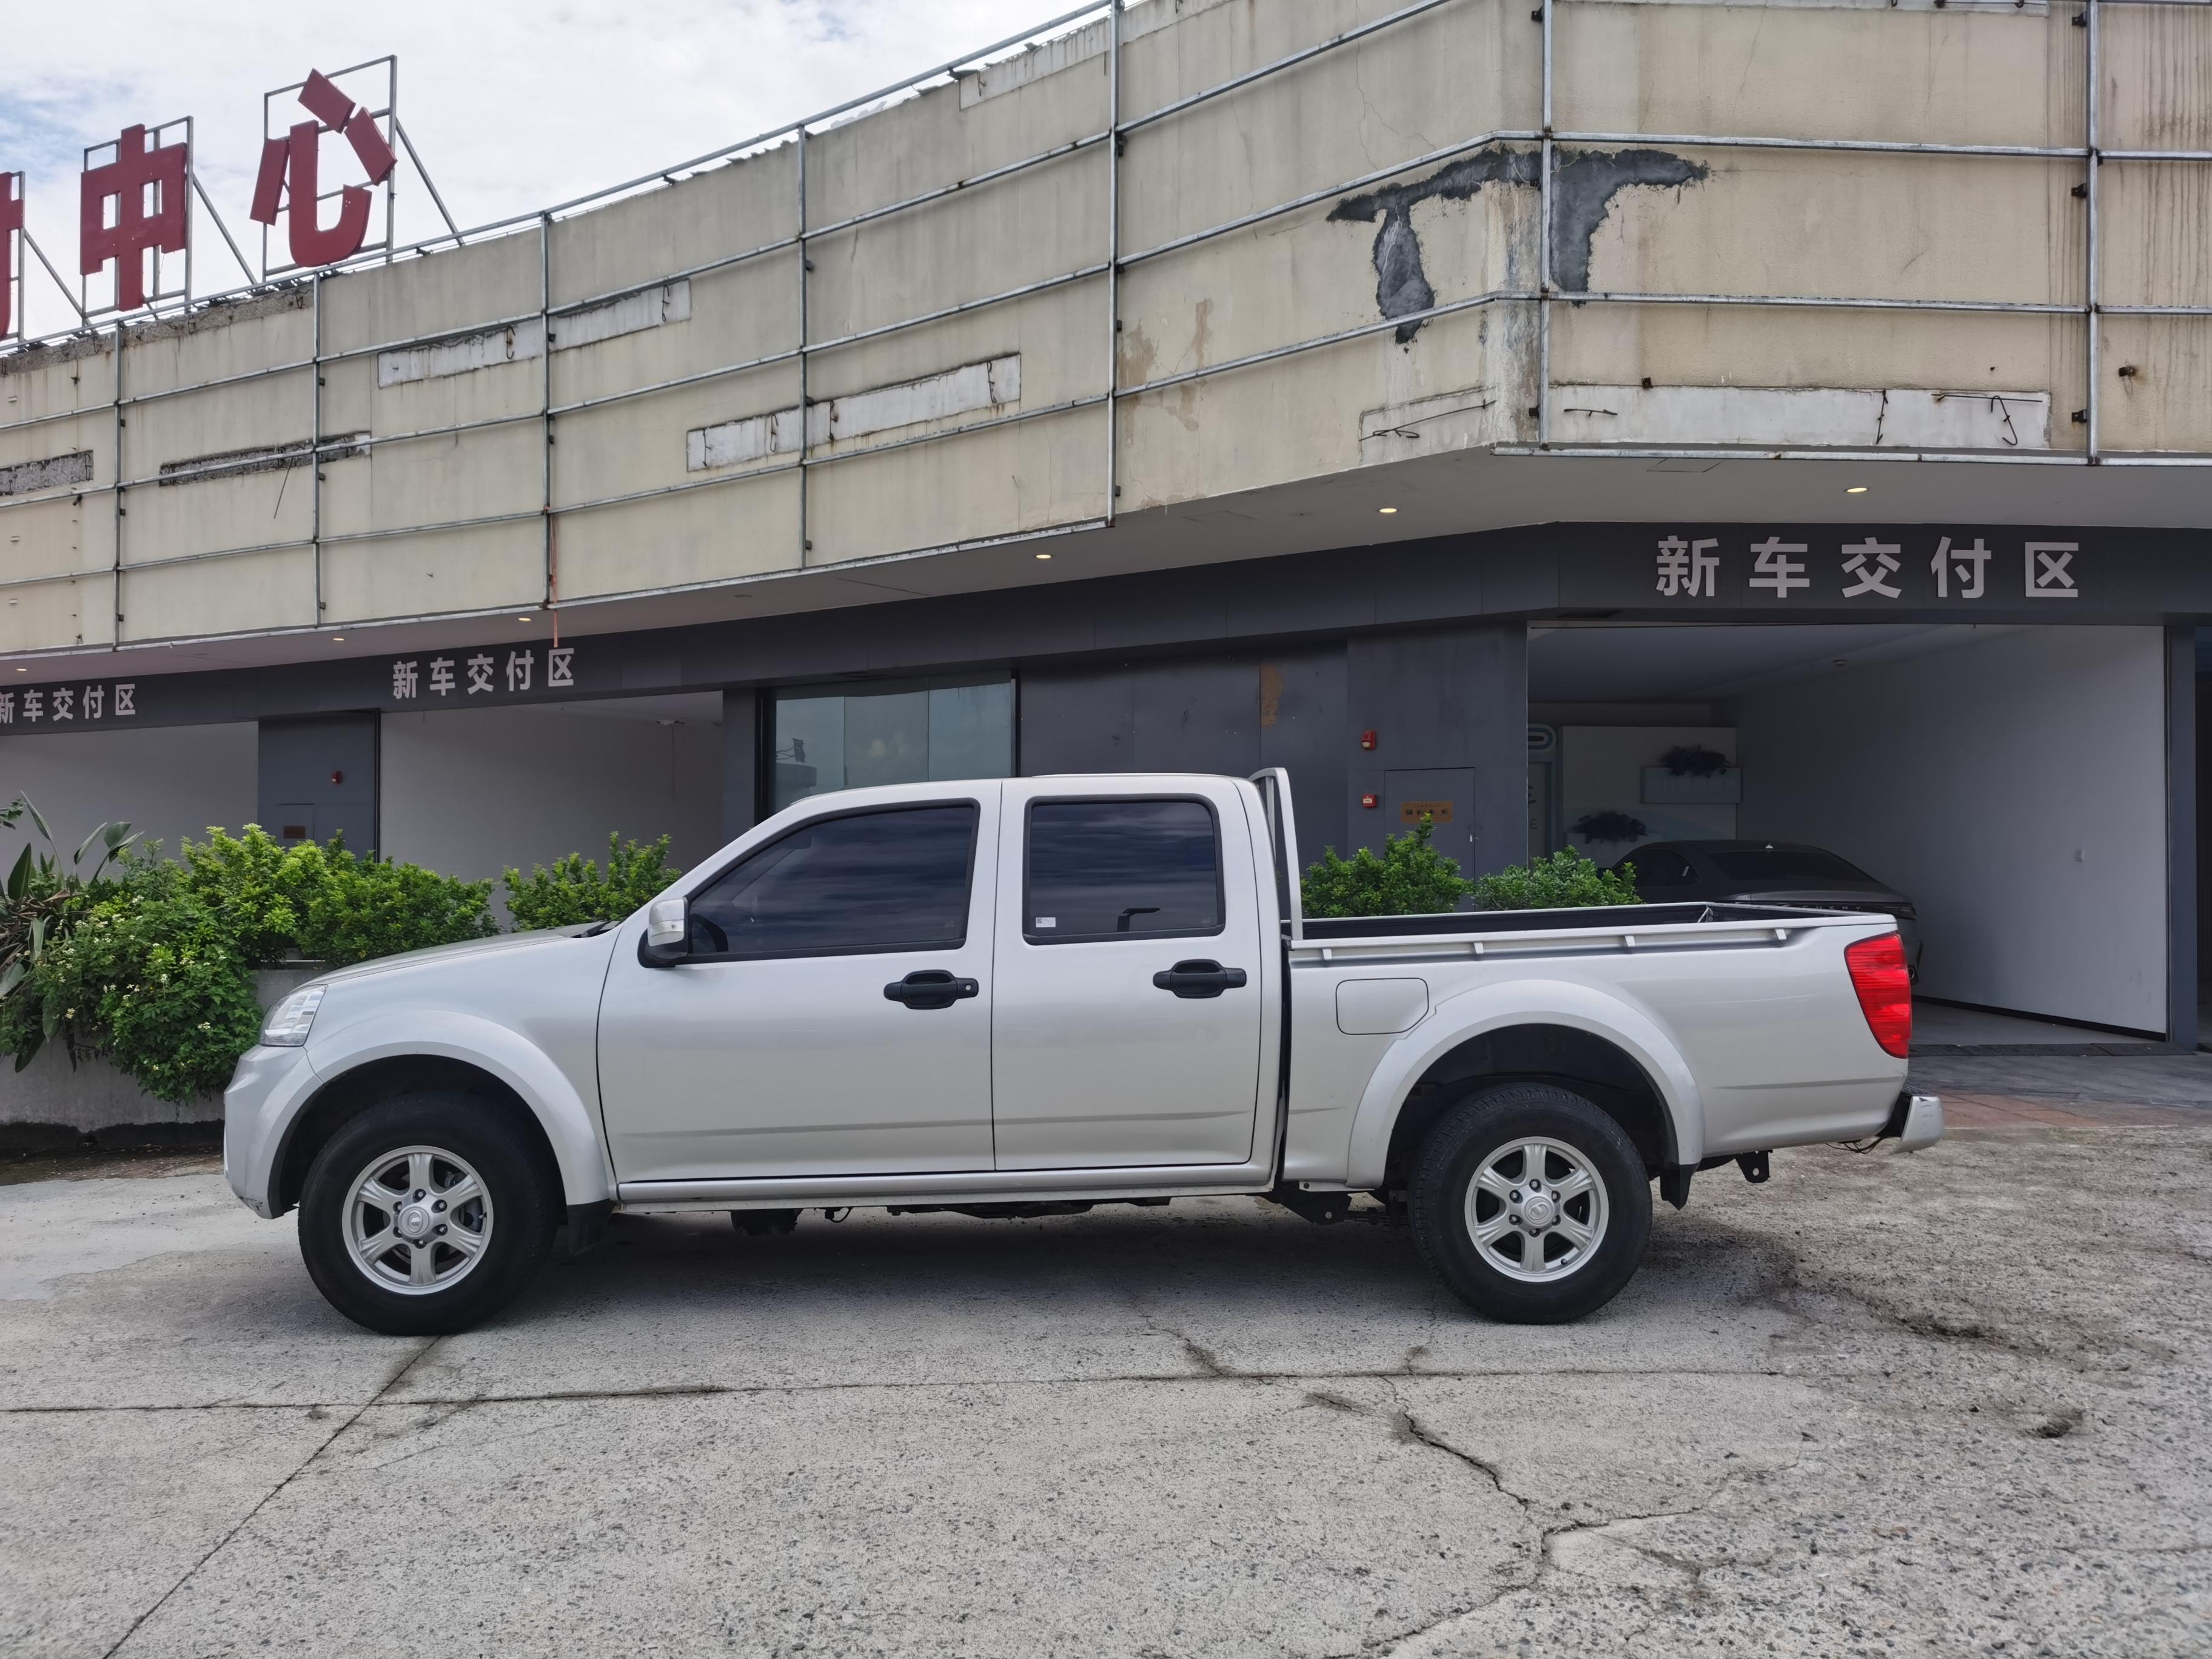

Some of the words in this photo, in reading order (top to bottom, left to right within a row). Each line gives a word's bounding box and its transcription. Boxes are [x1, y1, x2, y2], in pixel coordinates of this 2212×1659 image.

[0, 68, 398, 341] 中心
[1656, 535, 2079, 599] 新车交付区
[393, 648, 575, 699] 新车交付区
